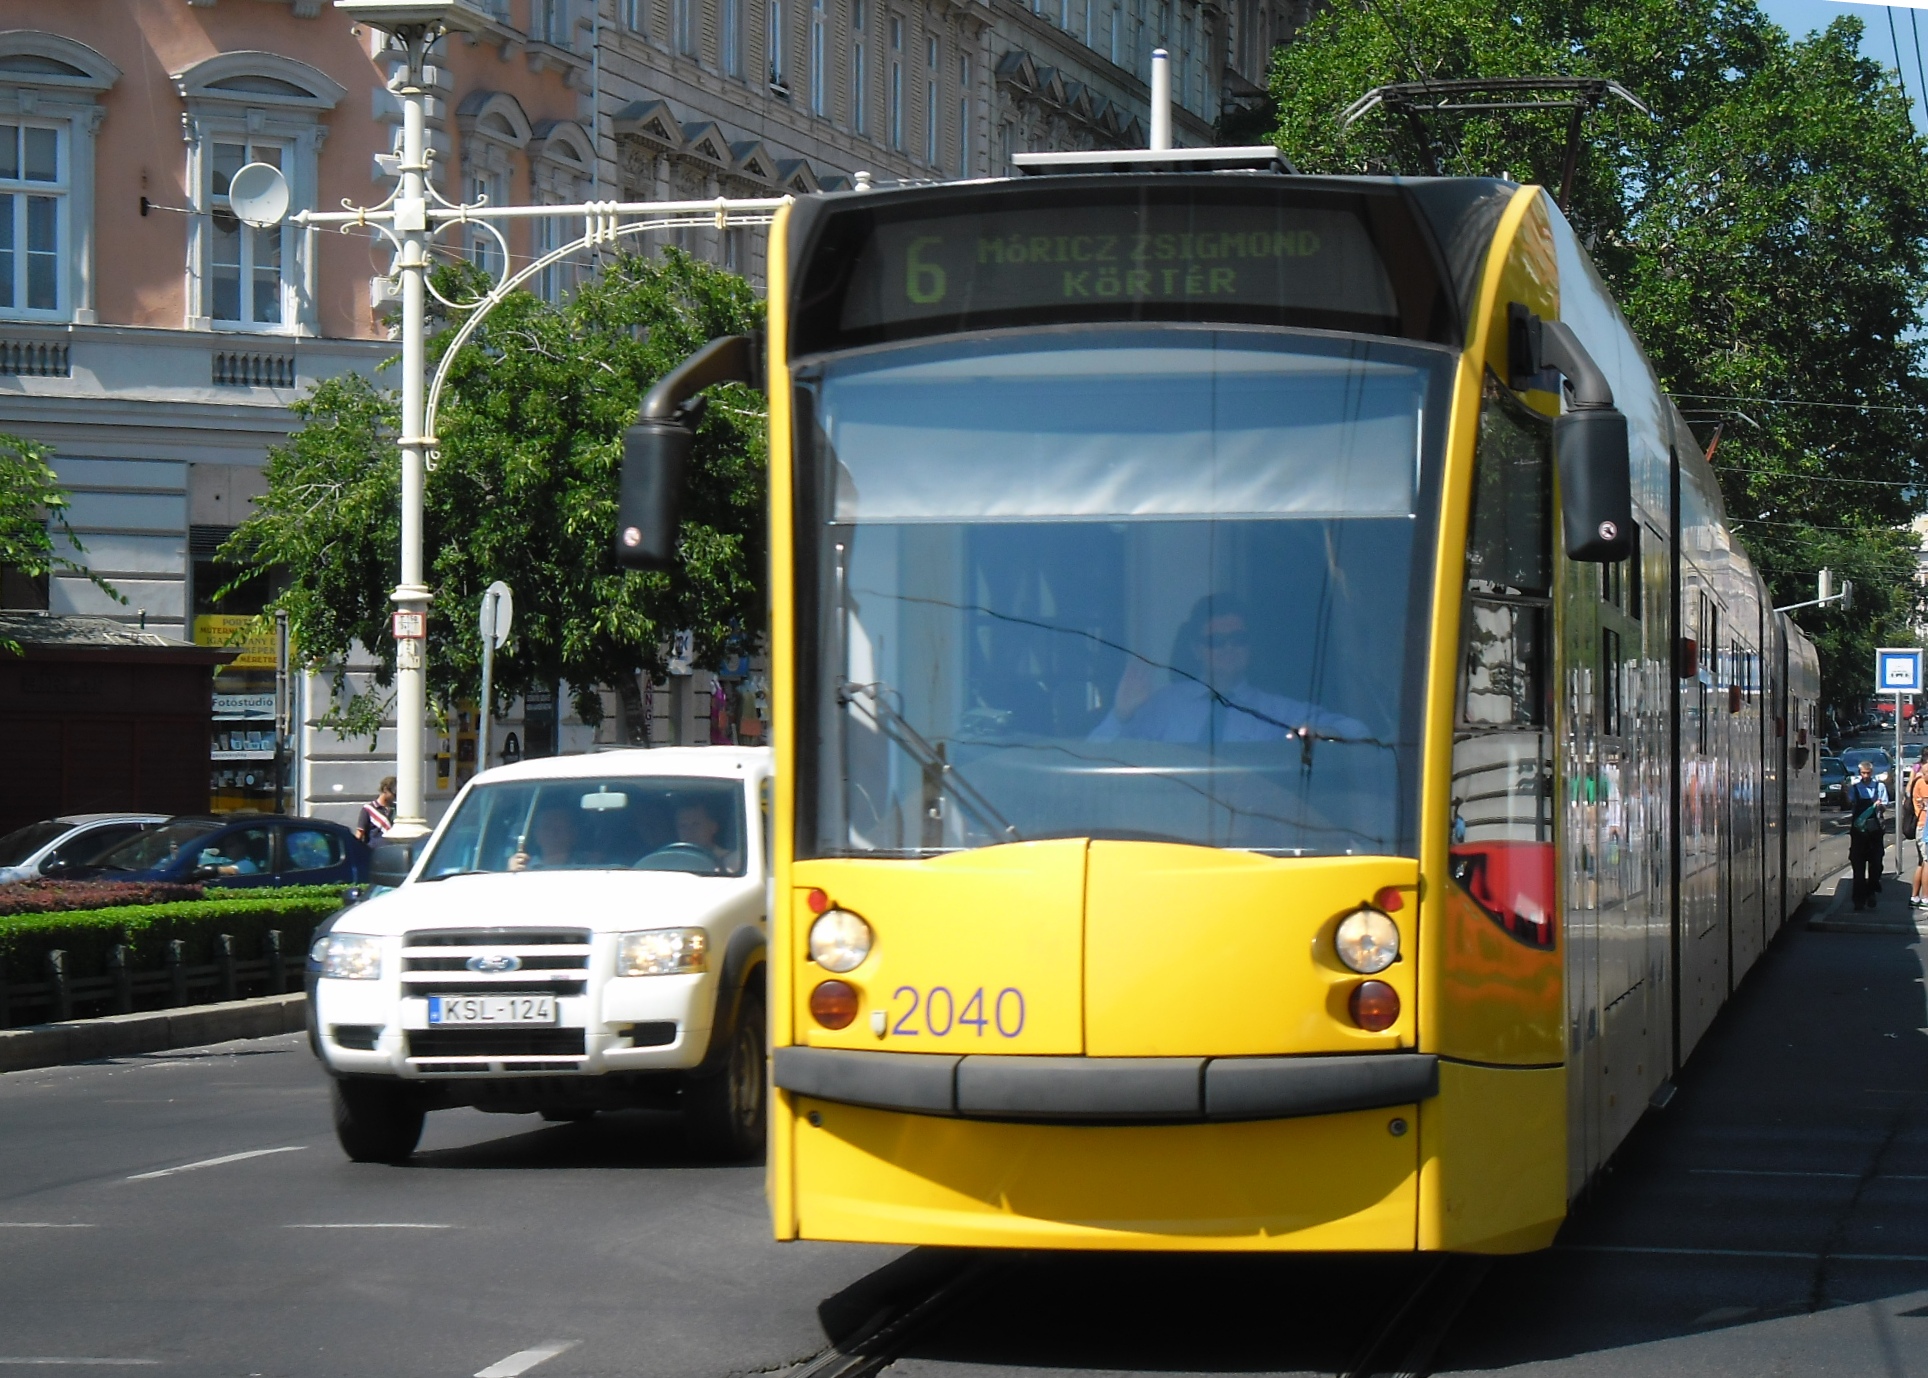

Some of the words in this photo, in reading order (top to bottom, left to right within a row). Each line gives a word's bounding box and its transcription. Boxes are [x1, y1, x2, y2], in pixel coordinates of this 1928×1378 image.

[1129, 230, 1321, 260] ZSIGMOND
[906, 236, 947, 303] 6
[1062, 265, 1237, 297] KÖRTÉR
[212, 697, 274, 707] Fotóstúdió
[446, 1000, 549, 1021] KSL-124
[892, 985, 1026, 1038] 2040
